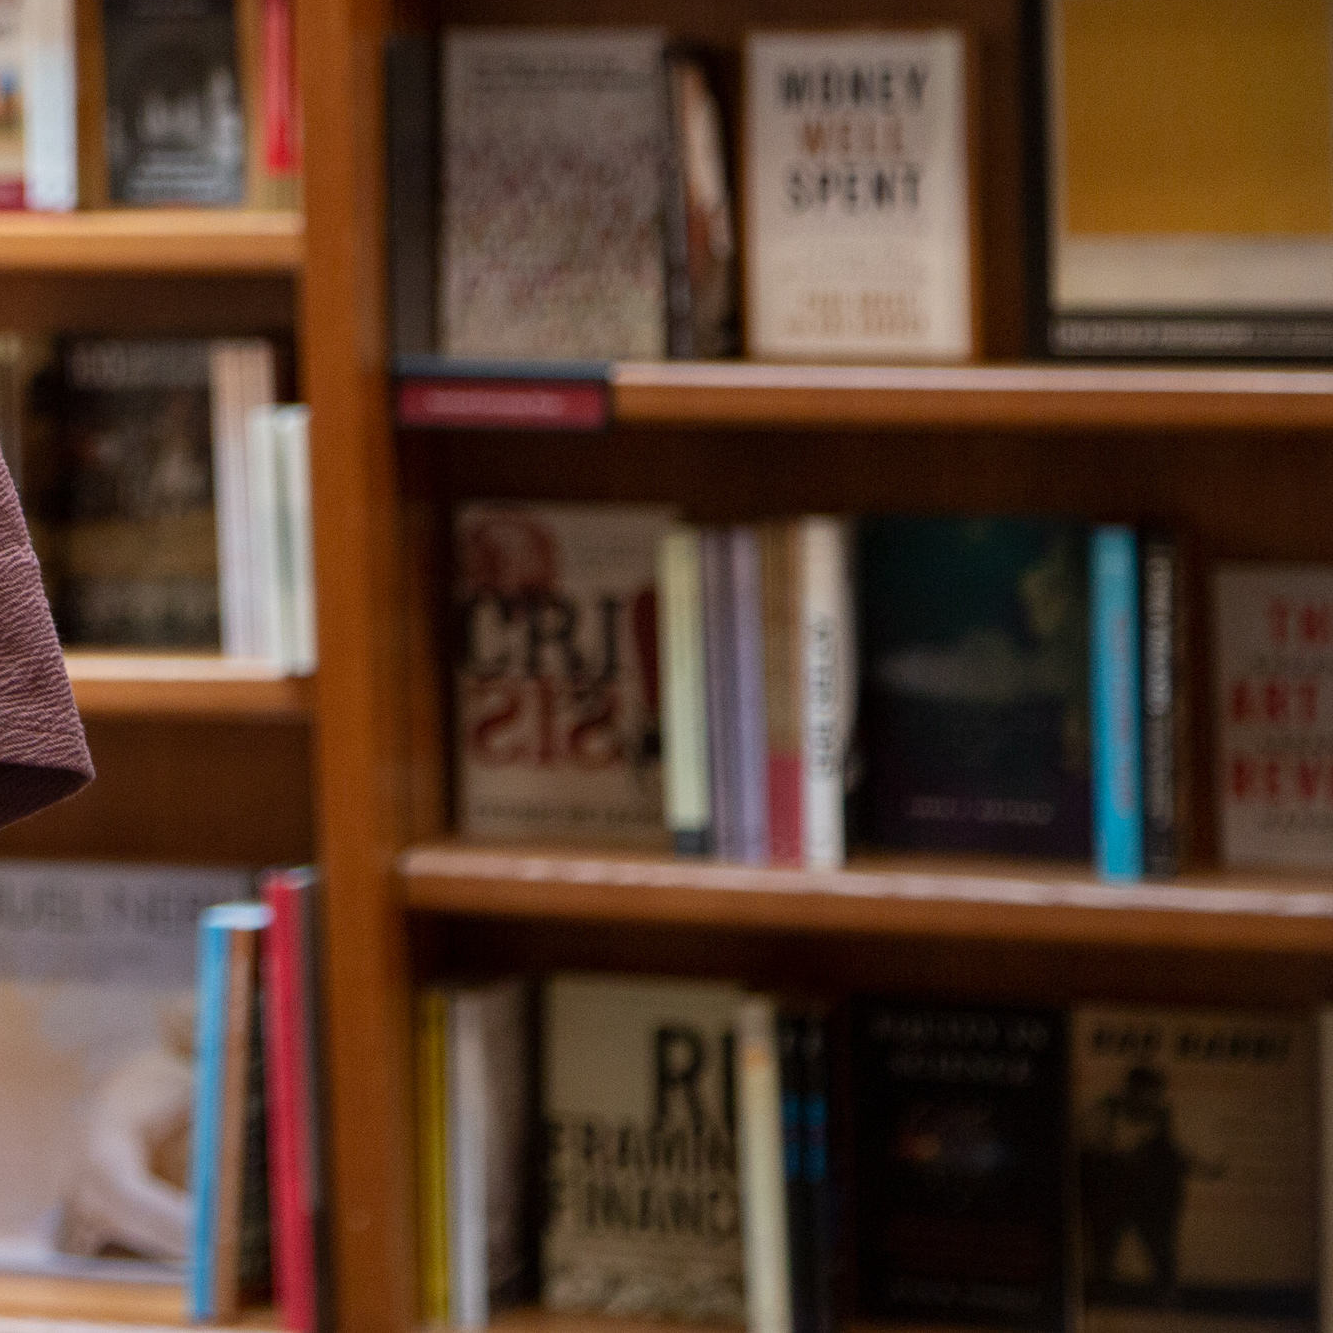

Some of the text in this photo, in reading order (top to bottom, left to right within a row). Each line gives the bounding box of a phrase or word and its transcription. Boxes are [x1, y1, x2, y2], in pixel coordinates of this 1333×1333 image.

[779, 65, 928, 110] MONEY
[797, 120, 903, 156] WELL
[789, 167, 920, 211] SPENT
